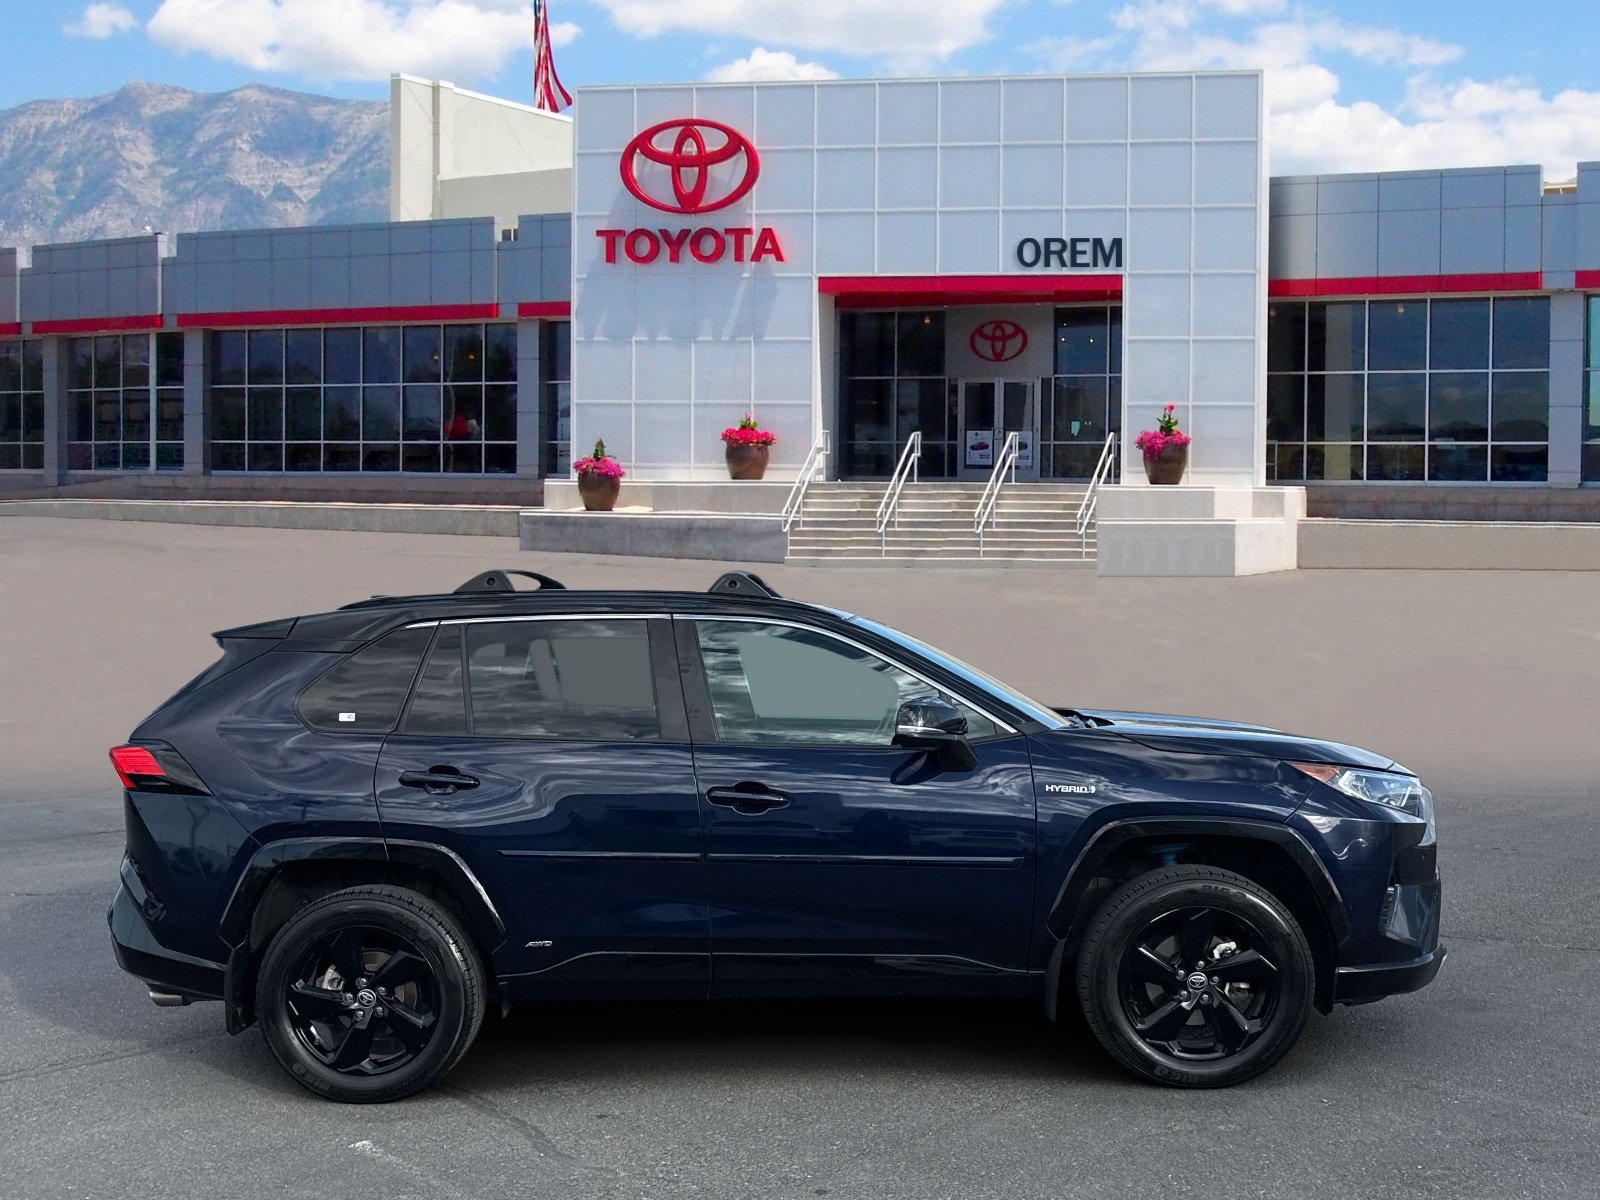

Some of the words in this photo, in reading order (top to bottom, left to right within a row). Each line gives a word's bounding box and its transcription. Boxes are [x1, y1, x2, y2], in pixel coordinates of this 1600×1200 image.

[596, 227, 785, 264] TOYOTA
[1017, 237, 1123, 268] OREM
[1045, 784, 1089, 794] HYBRID
